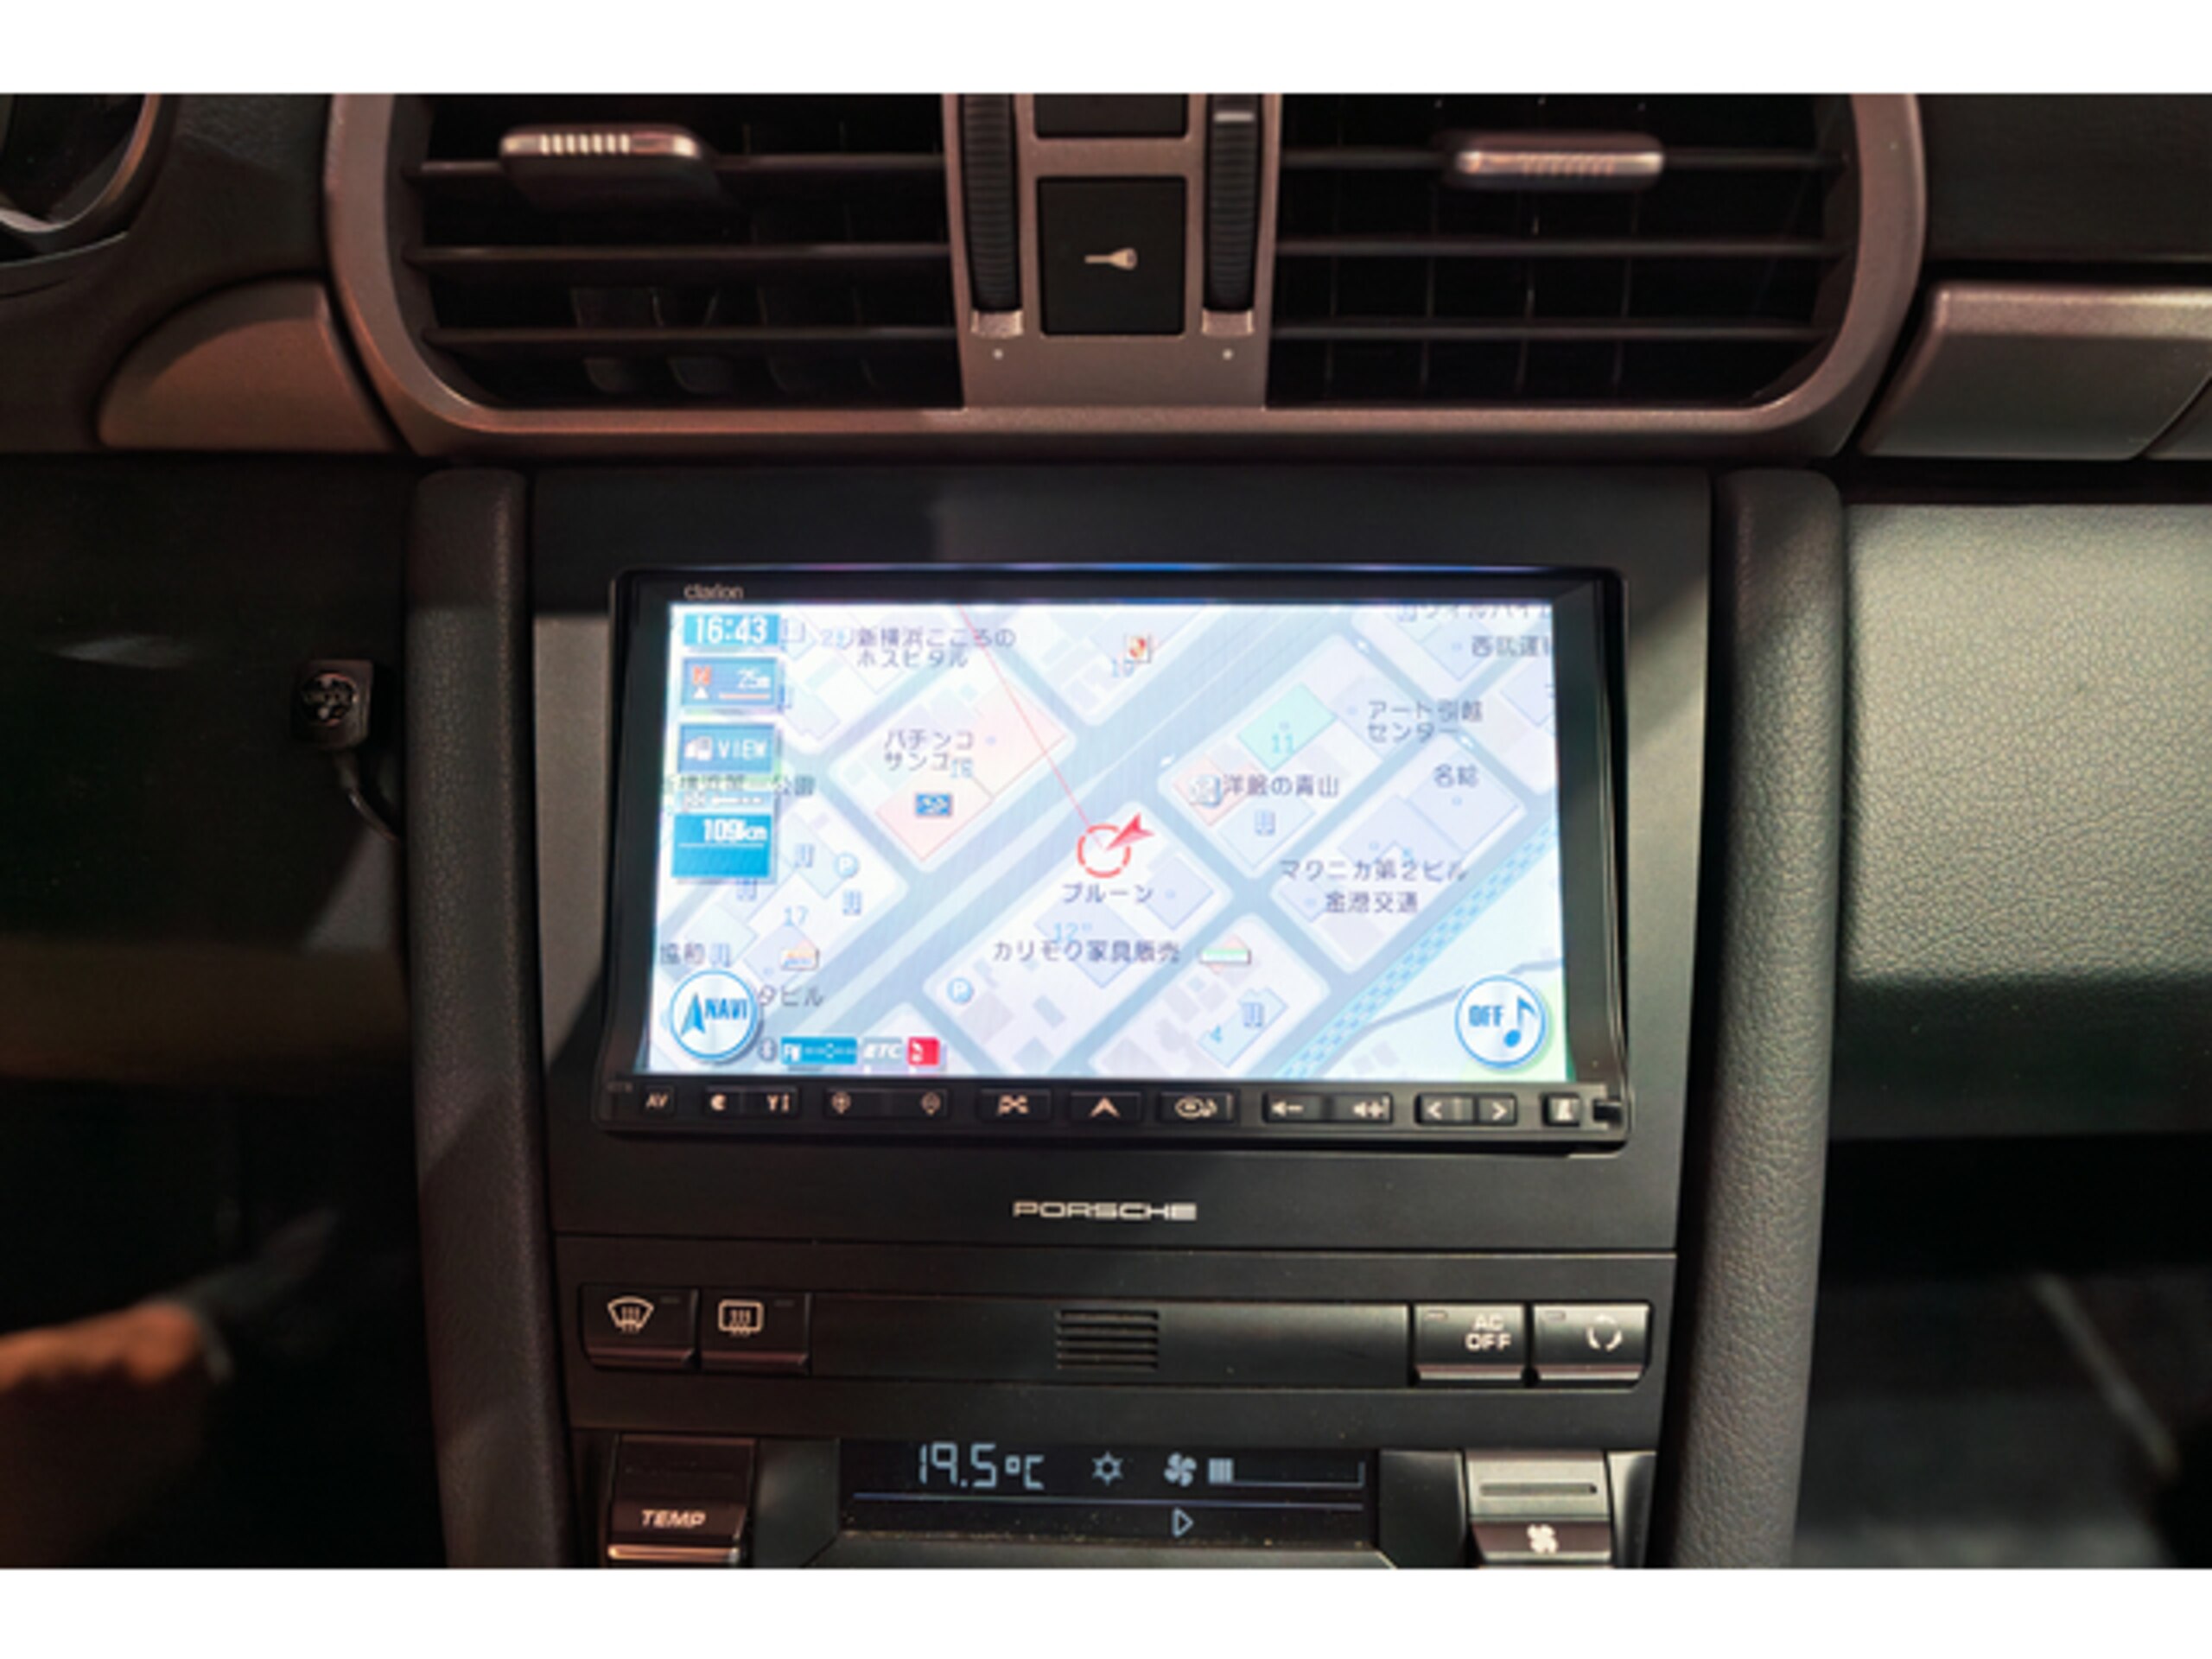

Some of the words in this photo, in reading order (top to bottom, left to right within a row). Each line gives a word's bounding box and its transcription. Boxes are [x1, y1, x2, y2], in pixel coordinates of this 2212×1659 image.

[696, 615, 768, 642] 16:43
[737, 669, 771, 690] 25m
[718, 740, 767, 758] VIEW
[704, 999, 748, 1020] NAVI
[1468, 1005, 1504, 1027] OFF
[863, 1042, 902, 1059] ETC
[1013, 1201, 1198, 1221] PORSCHE
[1472, 1313, 1505, 1332] AC
[1465, 1333, 1511, 1351] OFF
[641, 1510, 707, 1529] TEMP
